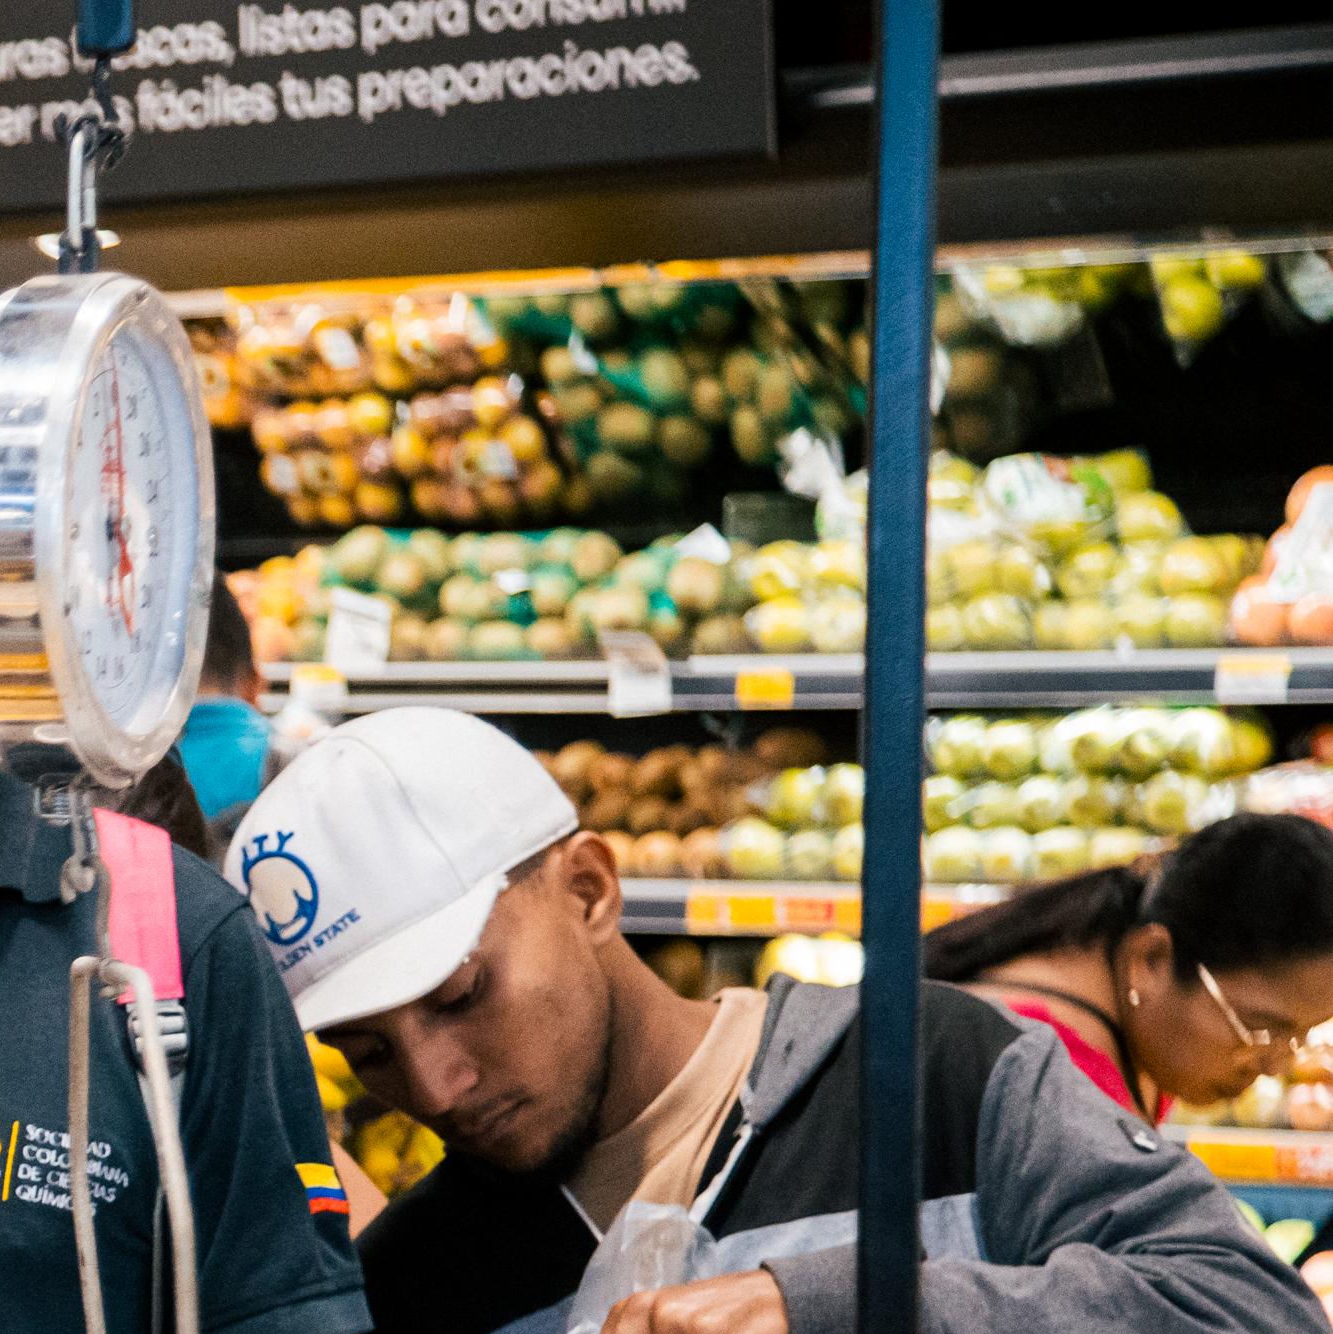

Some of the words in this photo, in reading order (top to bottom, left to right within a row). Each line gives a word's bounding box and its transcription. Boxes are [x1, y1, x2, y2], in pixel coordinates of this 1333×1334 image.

[239, 2, 355, 57] listas
[360, 0, 470, 55] para
[280, 70, 354, 120] tus
[313, 907, 361, 948] STATE
[17, 1163, 42, 1182] DE
